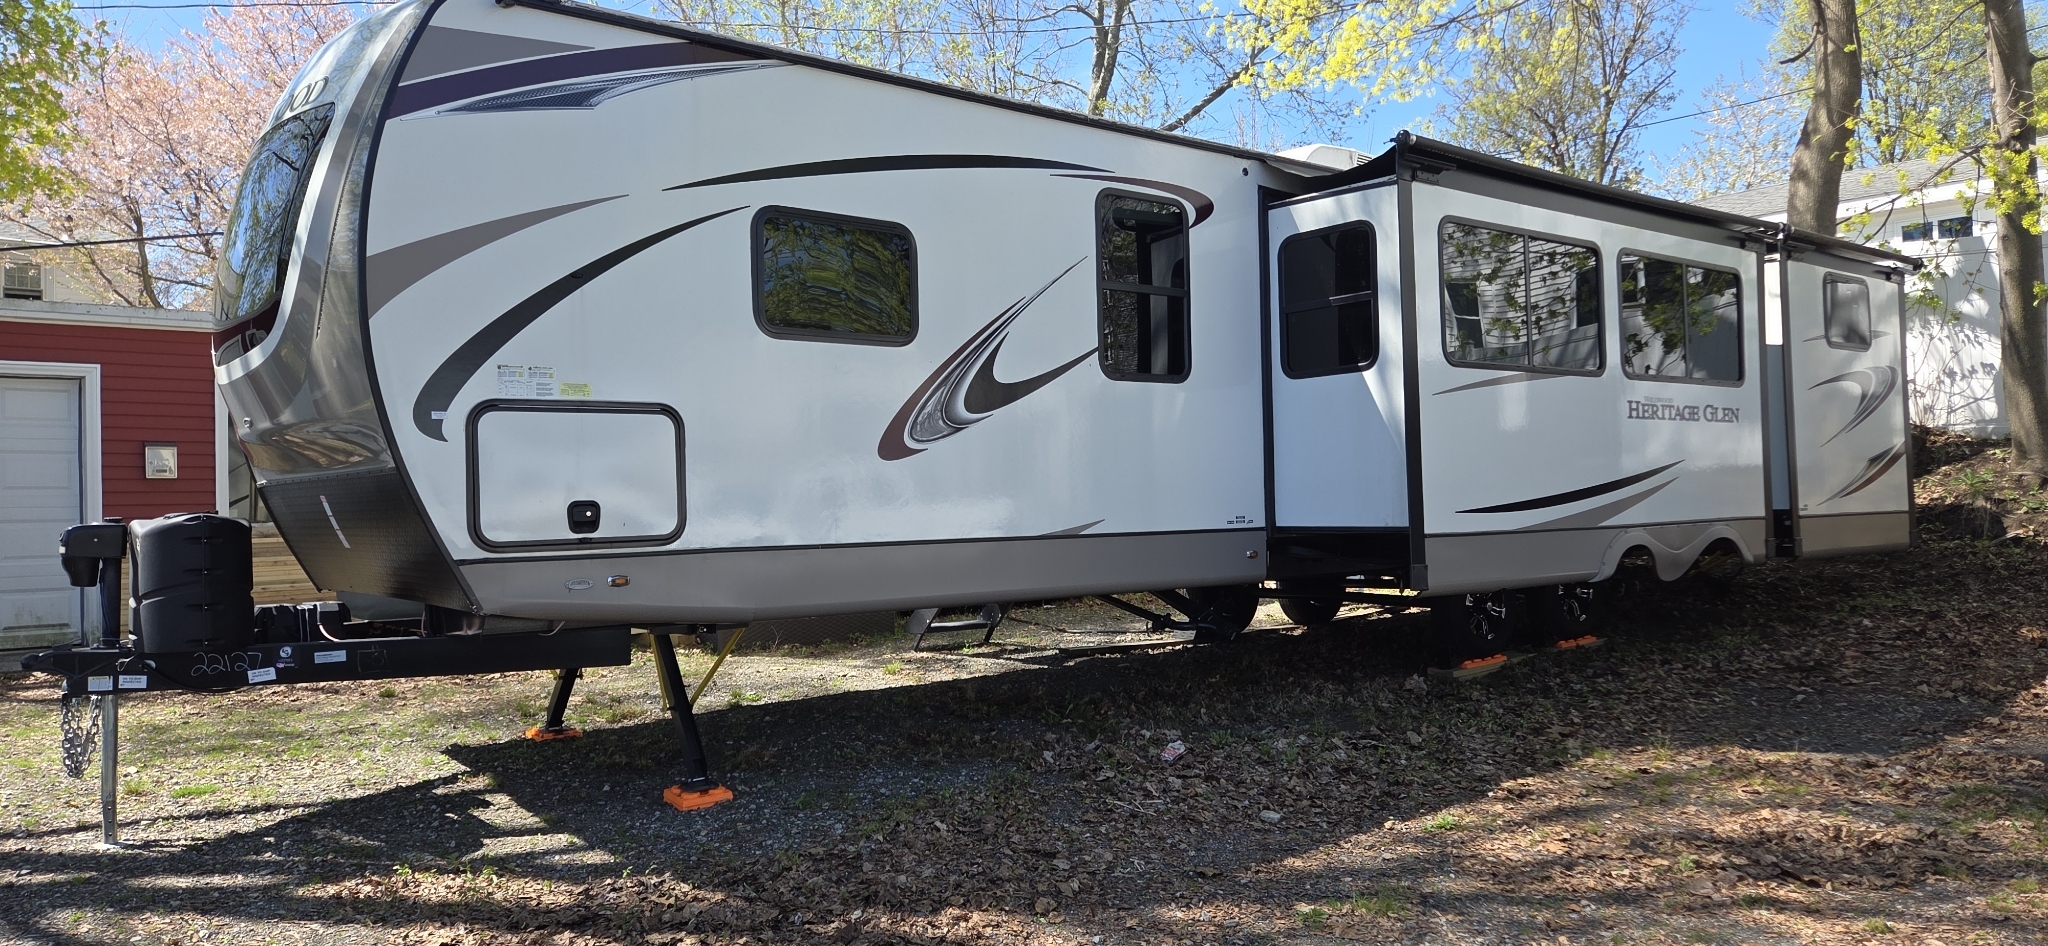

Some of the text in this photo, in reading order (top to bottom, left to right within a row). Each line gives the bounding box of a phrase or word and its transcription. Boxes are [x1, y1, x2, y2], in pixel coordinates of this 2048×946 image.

[1627, 400, 1740, 423] HERITAGE GLEN
[191, 651, 262, 677] 22127
